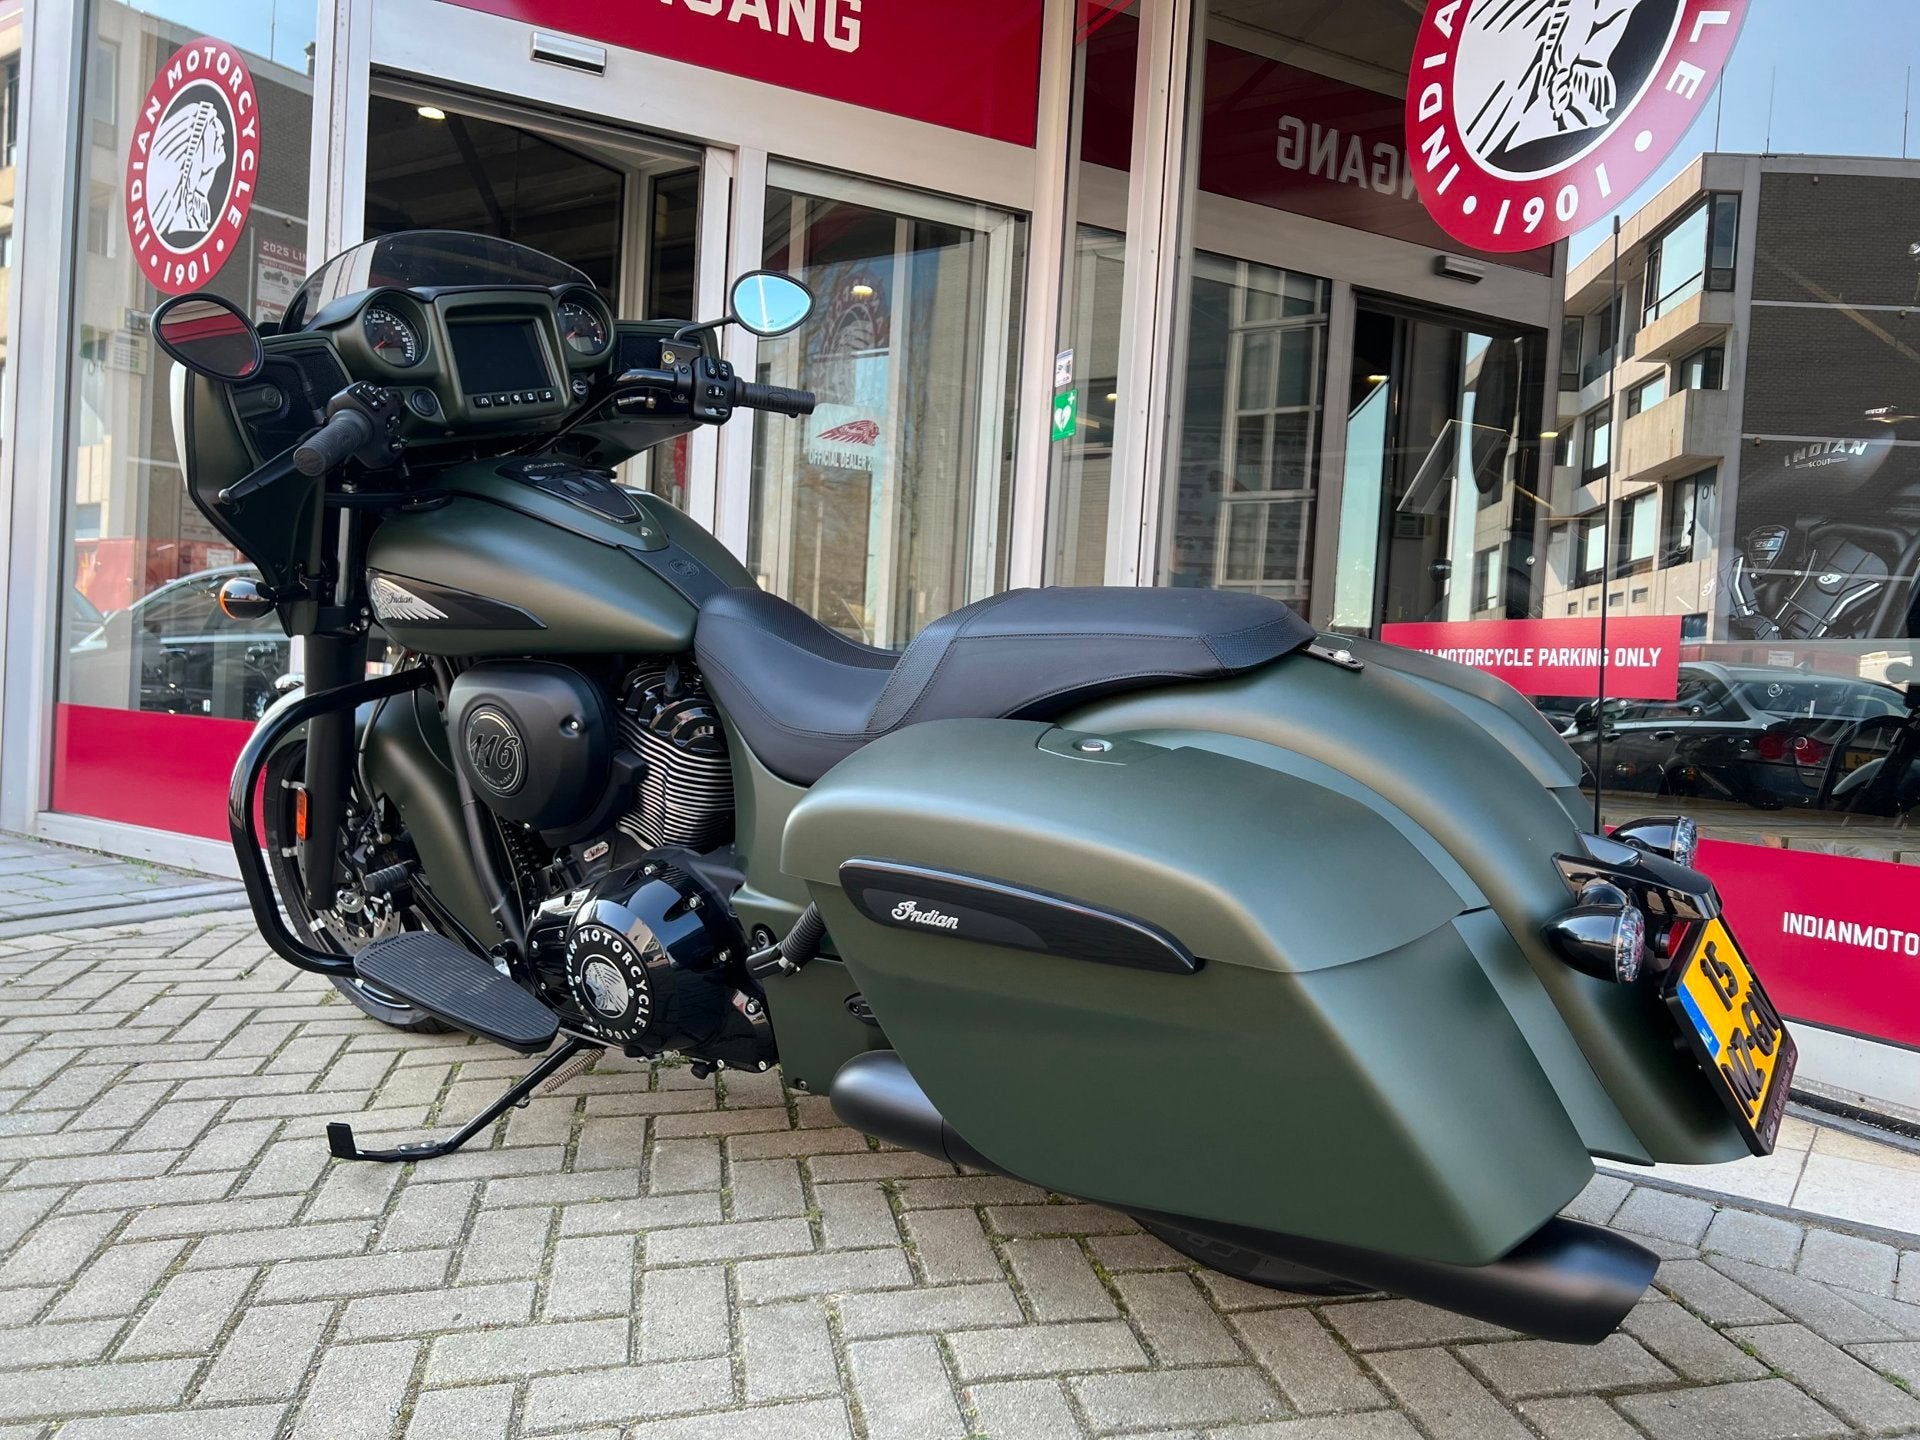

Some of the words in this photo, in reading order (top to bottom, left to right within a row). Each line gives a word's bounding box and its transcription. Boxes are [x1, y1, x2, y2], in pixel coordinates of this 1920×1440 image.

[131, 95, 162, 252] INDIAN
[167, 46, 257, 230] MOTORCYCLE
[1492, 162, 1612, 235] 1901
[262, 241, 290, 258] 2025
[162, 251, 210, 286] 1901
[808, 449, 839, 468] OFFICIAL
[840, 453, 867, 471] DEALER
[1784, 439, 1869, 468] INDIAN
[1808, 457, 1831, 468] SCOUT
[386, 591, 414, 605] Indian
[1437, 647, 1534, 667] MOTORCYCLE
[1537, 647, 1609, 667] PARKING
[1614, 647, 1662, 667] ONLY
[471, 733, 521, 770] 116
[891, 900, 959, 930] Indian
[1782, 911, 1920, 957] INDIANMOTO
[579, 928, 650, 1028] MOTORCYCLE
[1700, 940, 1740, 1013] 15
